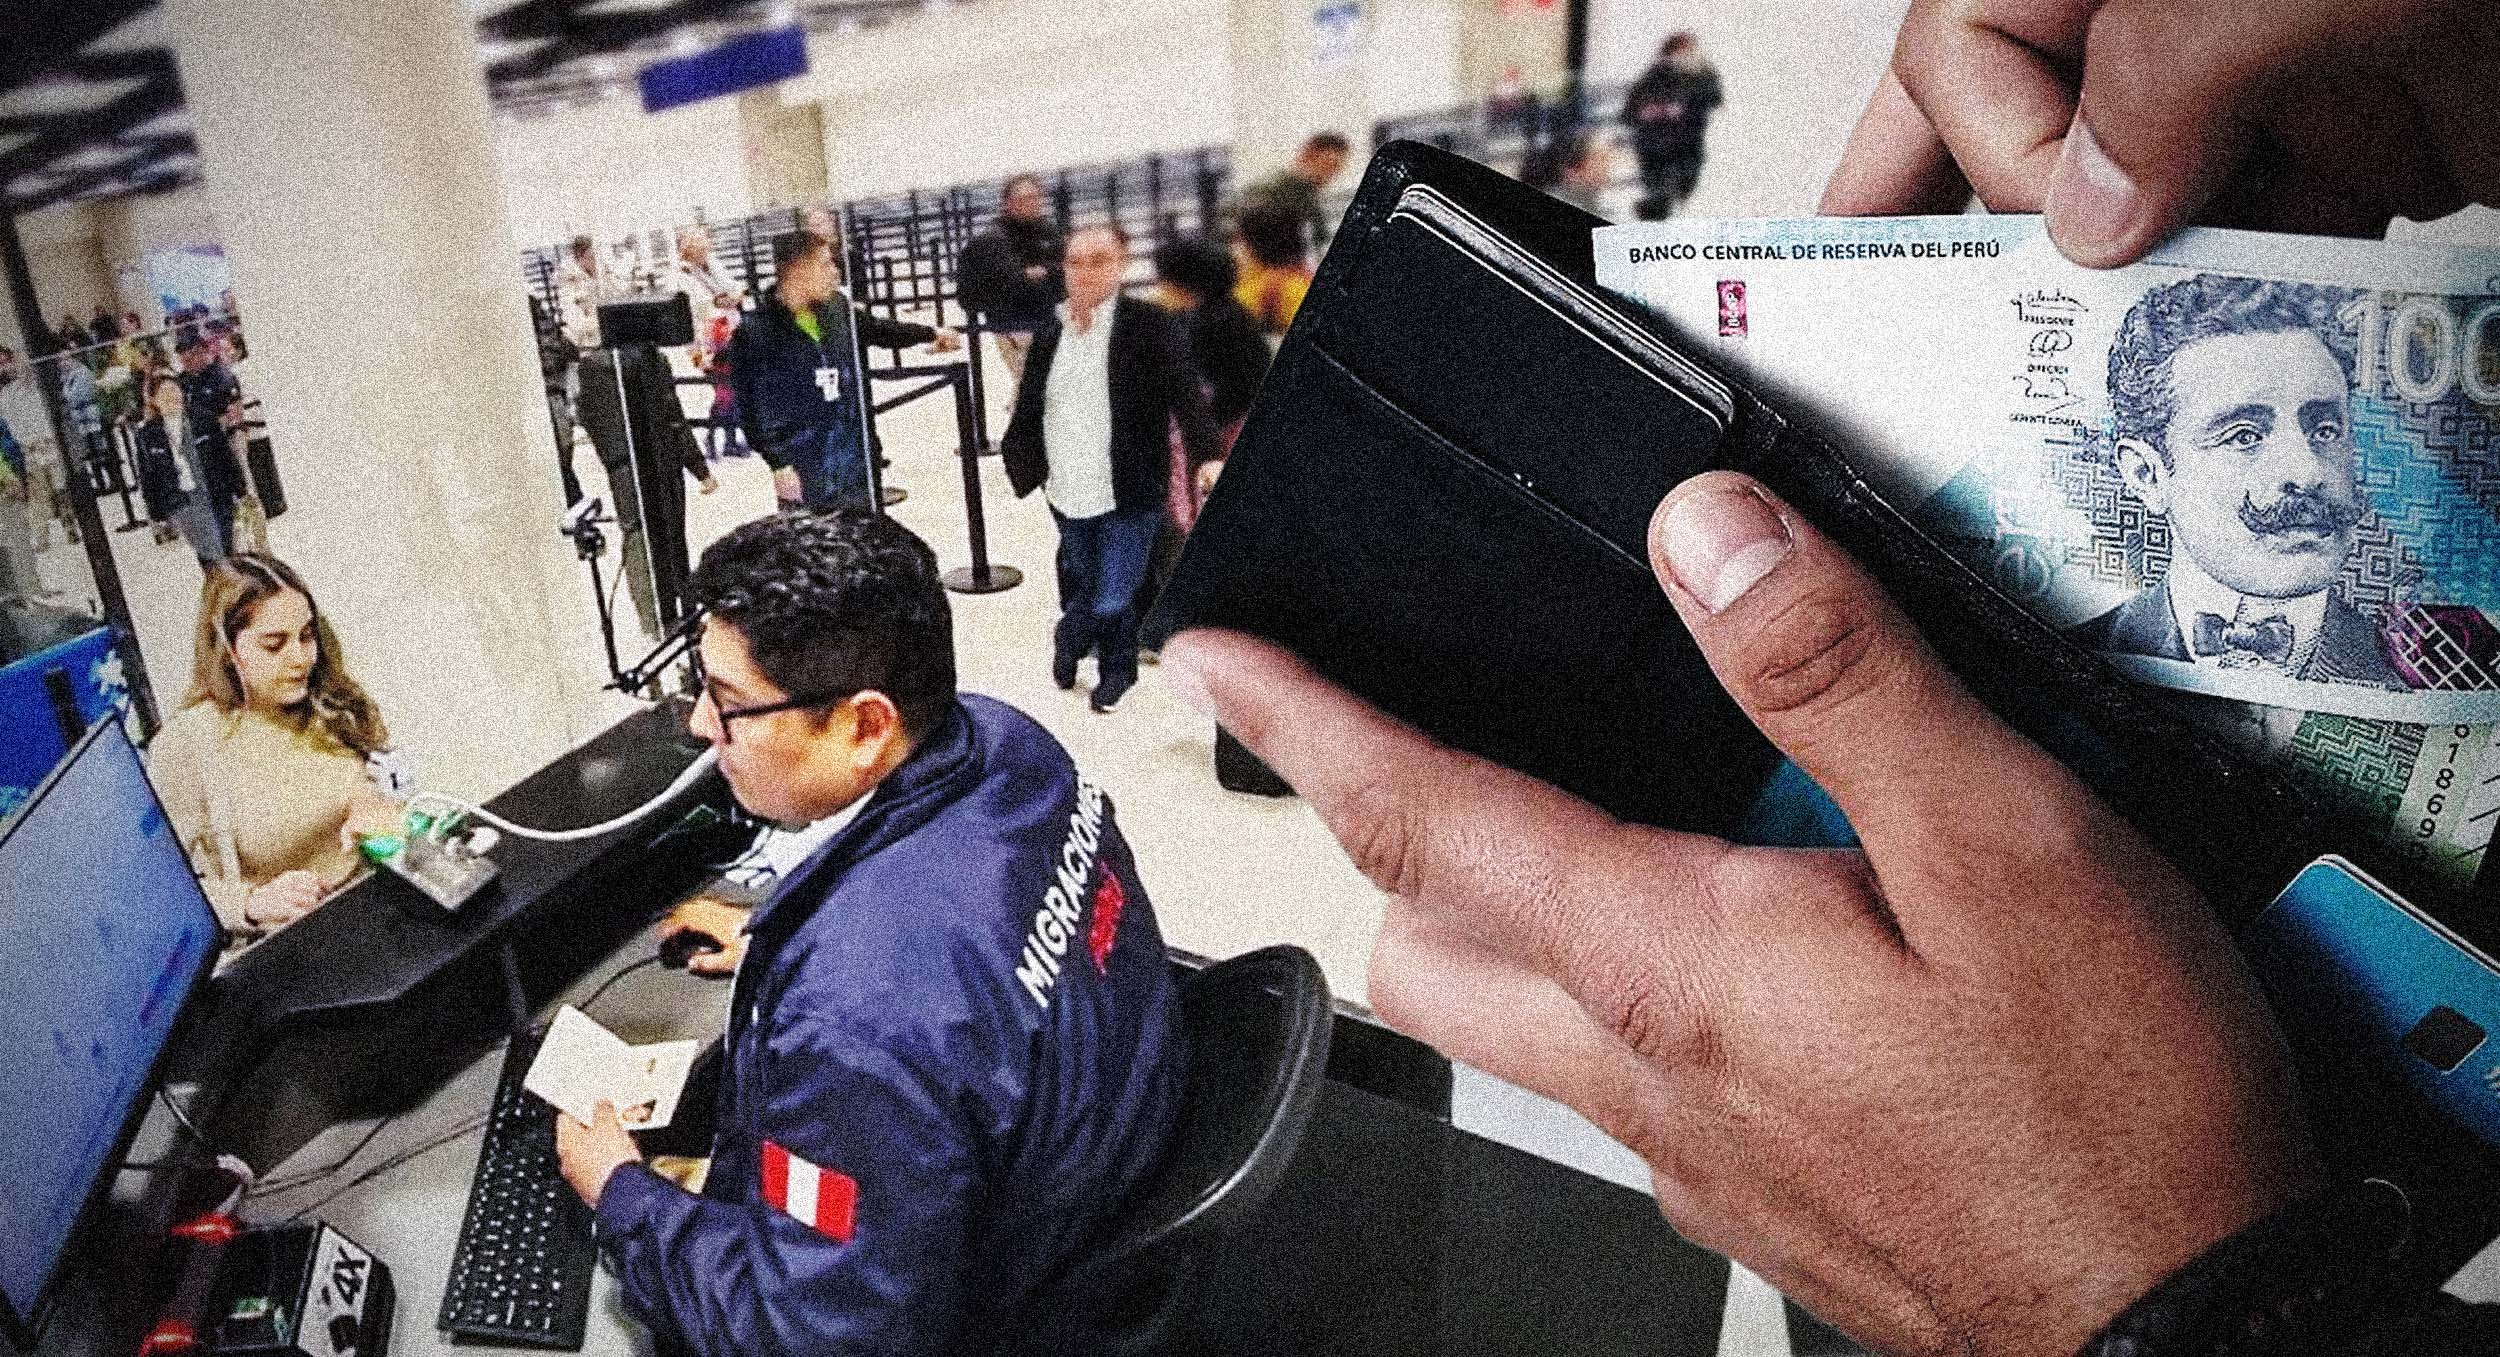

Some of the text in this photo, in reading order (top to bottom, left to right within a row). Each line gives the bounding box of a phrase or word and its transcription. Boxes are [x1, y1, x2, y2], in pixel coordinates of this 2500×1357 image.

[1629, 237, 2000, 263] BANCO CENTRAL DE RESERVA DEL PERÚ
